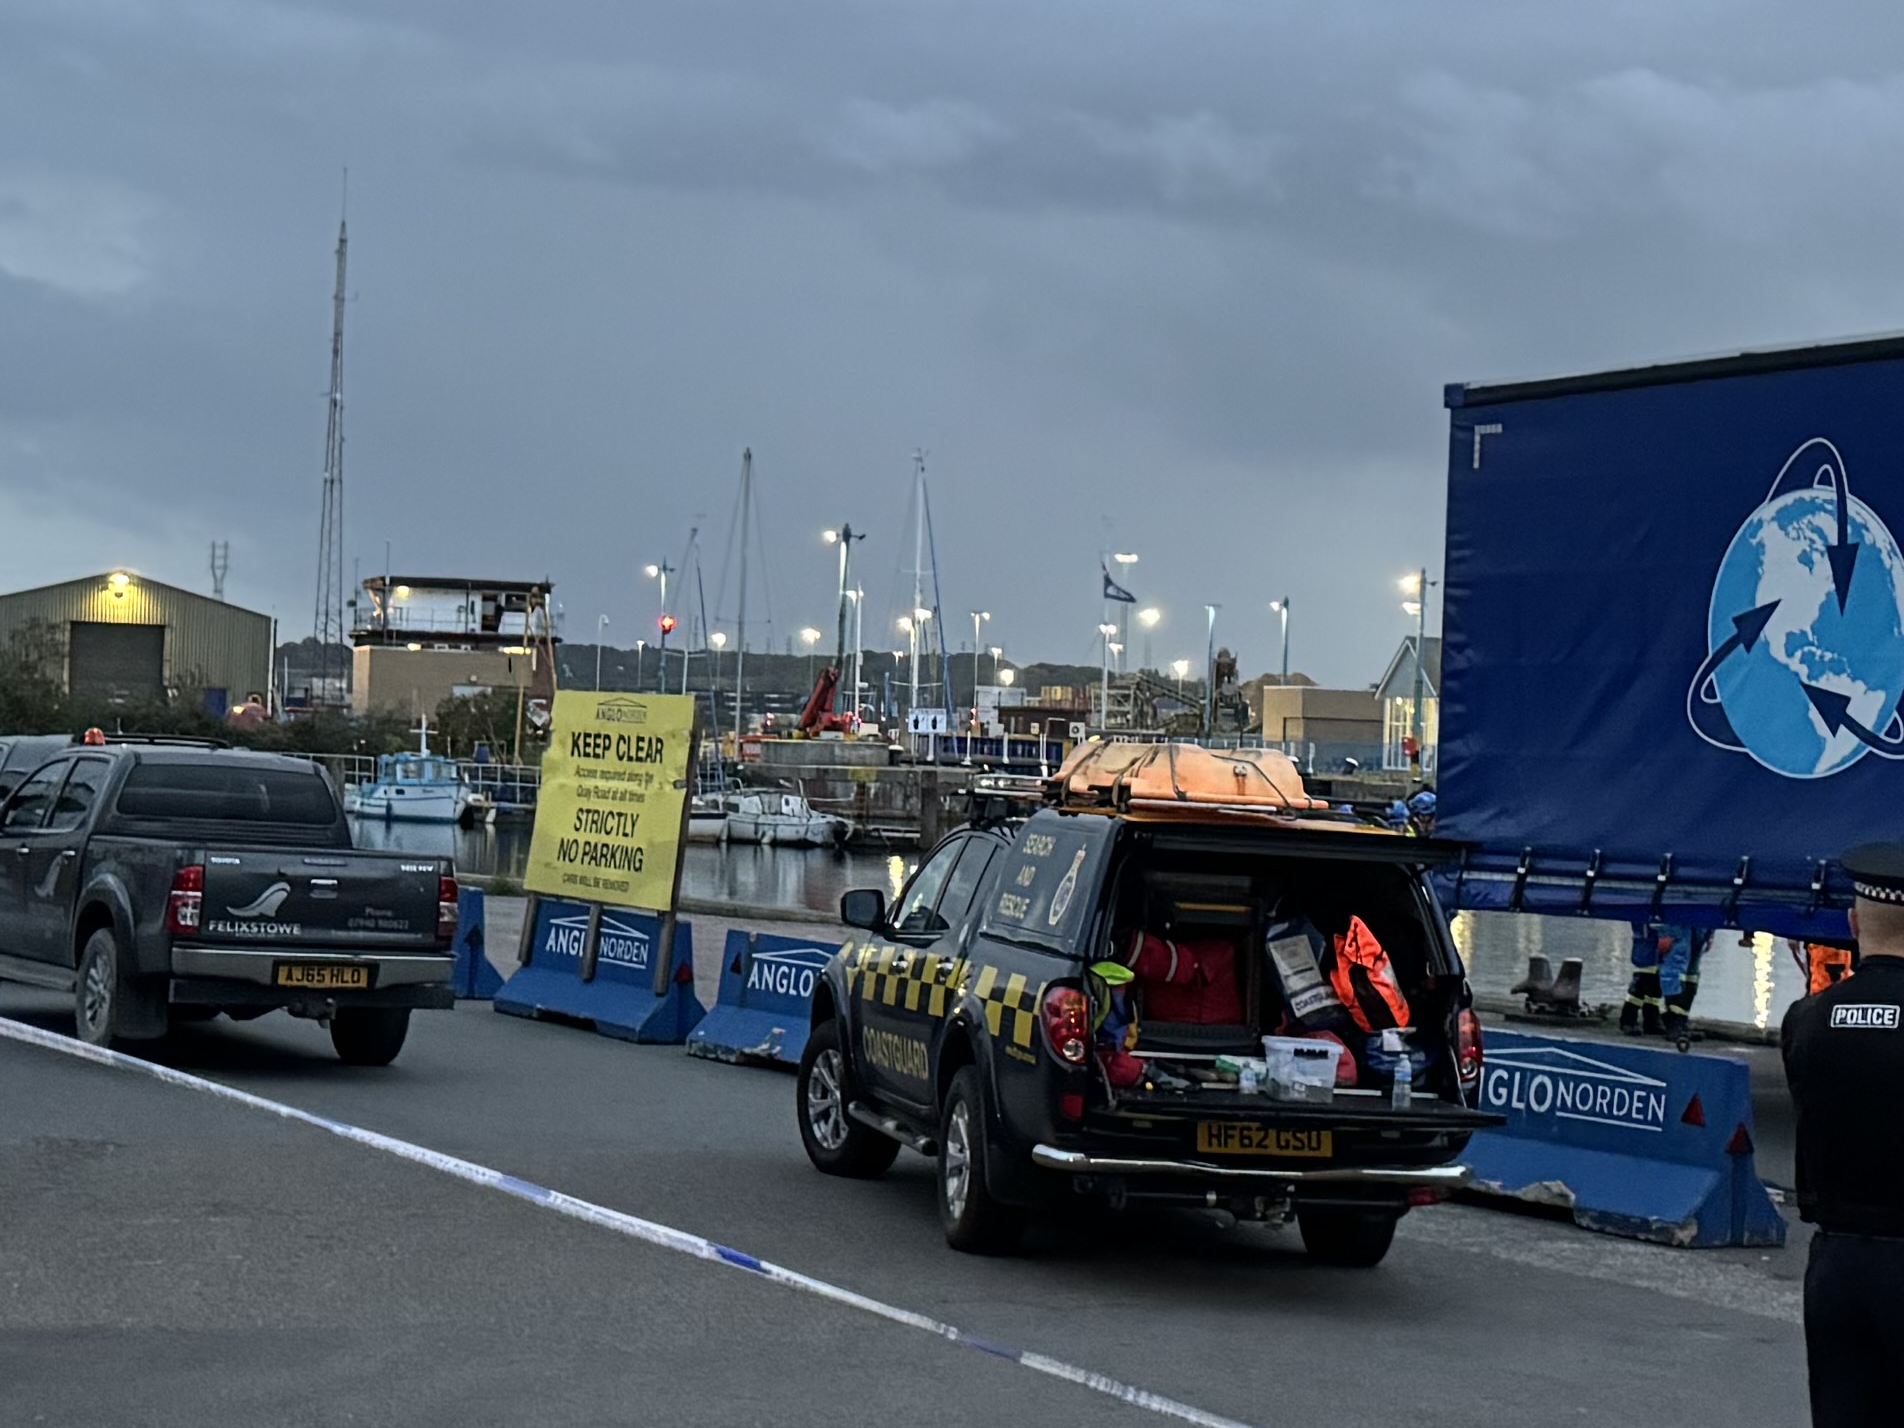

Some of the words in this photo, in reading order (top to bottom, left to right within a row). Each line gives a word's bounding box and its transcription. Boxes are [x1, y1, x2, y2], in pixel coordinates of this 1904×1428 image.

[571, 731, 612, 760] KEEP
[616, 733, 664, 764] CLEAR
[574, 808, 640, 838] STRICTLY
[557, 838, 579, 863] NO
[581, 841, 644, 872] PARKING
[209, 920, 302, 935] FELIXSTOWE
[285, 967, 326, 983] AJ65
[1835, 1008, 1895, 1025] POLICE
[862, 1025, 929, 1081] COASTGUARD
[1207, 1124, 1269, 1149] HF62
